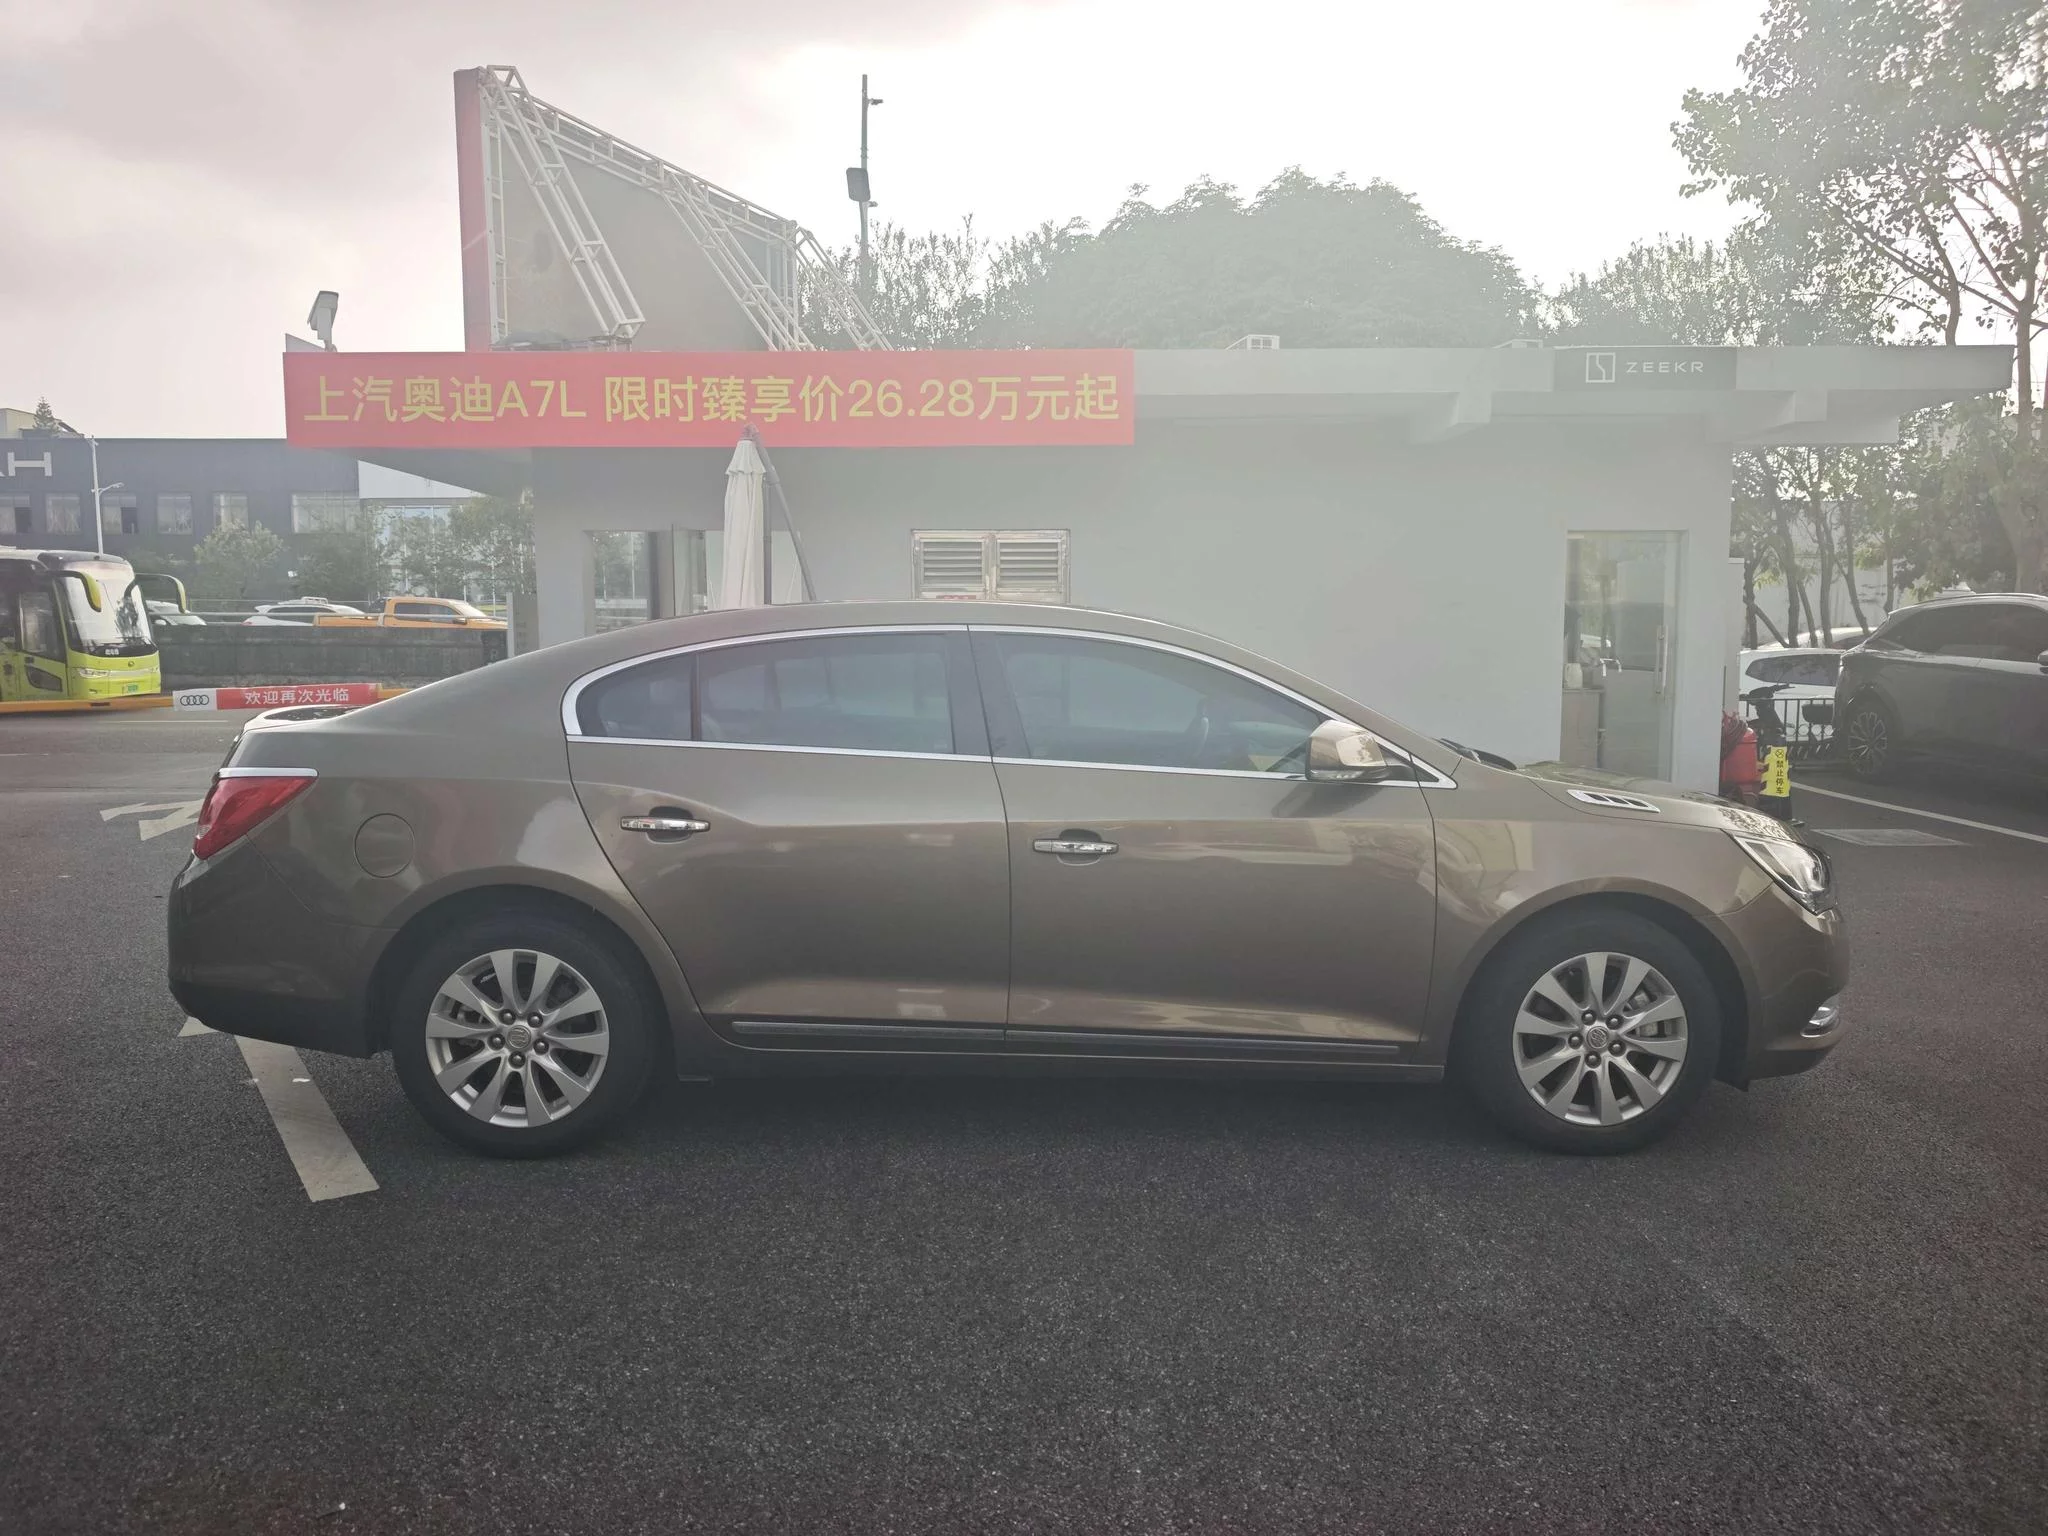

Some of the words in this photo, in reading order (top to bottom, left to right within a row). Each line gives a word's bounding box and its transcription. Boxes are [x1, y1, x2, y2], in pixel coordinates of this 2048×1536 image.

[1626, 361, 1704, 373] ZEEKR
[303, 375, 587, 422] 上汽奥迪A7L
[605, 373, 1120, 424] 限时臻享价26.28万元起
[0, 451, 52, 477] H
[245, 688, 349, 705] 欢迎再次光临
[1775, 760, 1785, 794] 禁止停车
